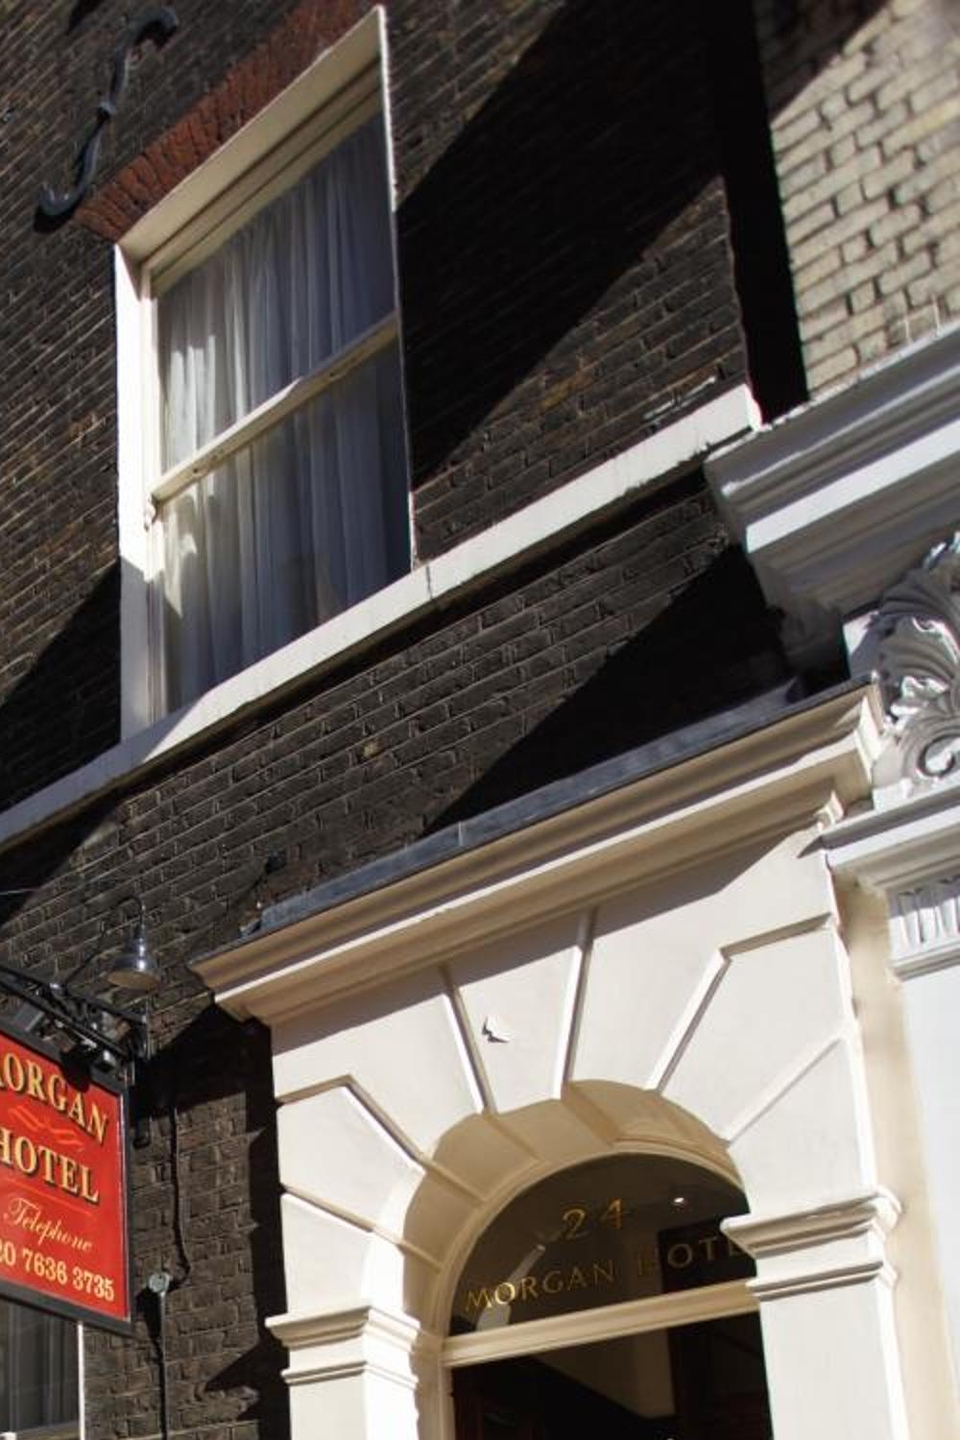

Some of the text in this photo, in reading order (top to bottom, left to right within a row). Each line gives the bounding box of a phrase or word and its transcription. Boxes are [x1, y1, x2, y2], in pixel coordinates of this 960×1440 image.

[3, 1197, 92, 1254] Telephone
[21, 1248, 68, 1285] 7636
[72, 1267, 115, 1302] 3735
[465, 1259, 616, 1312] MORGAN
